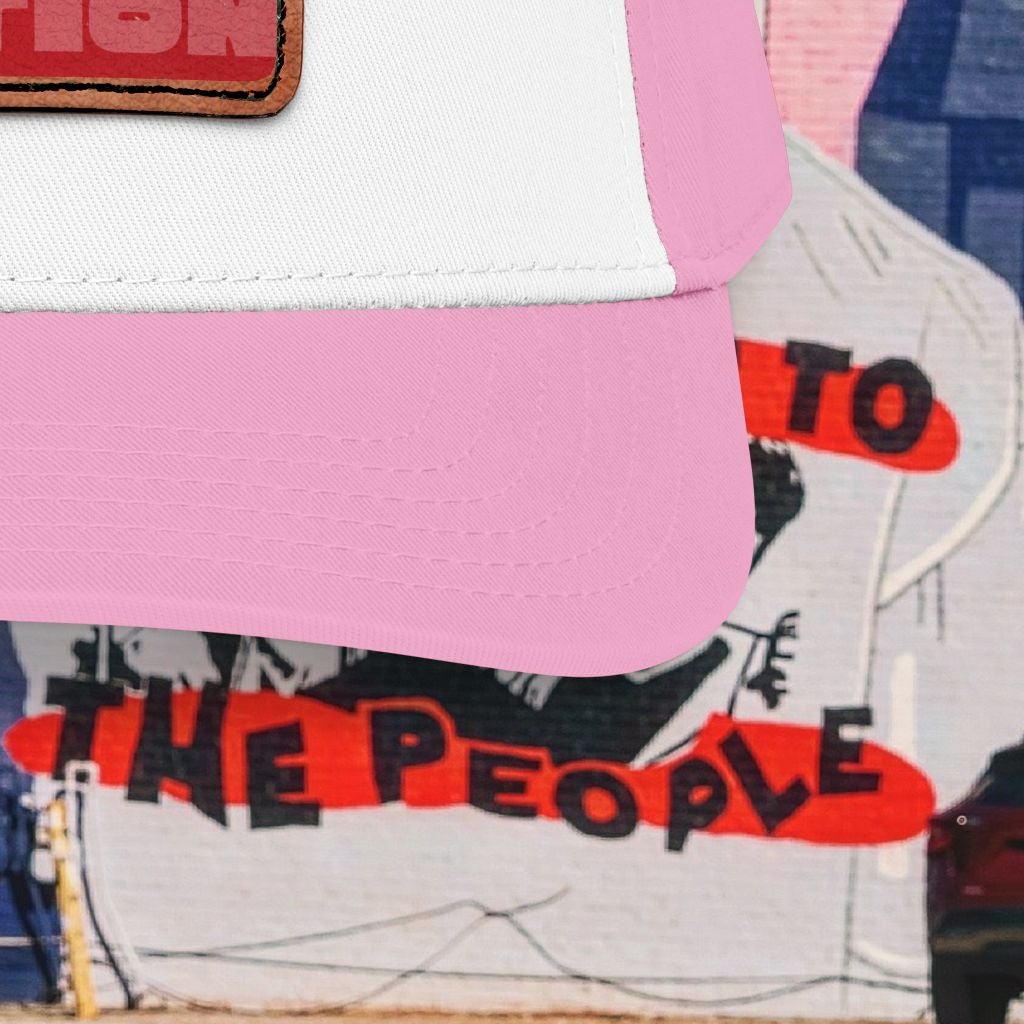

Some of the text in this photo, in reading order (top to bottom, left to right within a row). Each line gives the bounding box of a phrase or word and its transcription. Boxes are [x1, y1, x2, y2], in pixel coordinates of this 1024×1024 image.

[785, 340, 933, 454] TO
[46, 676, 883, 852] THE PEOPLE
